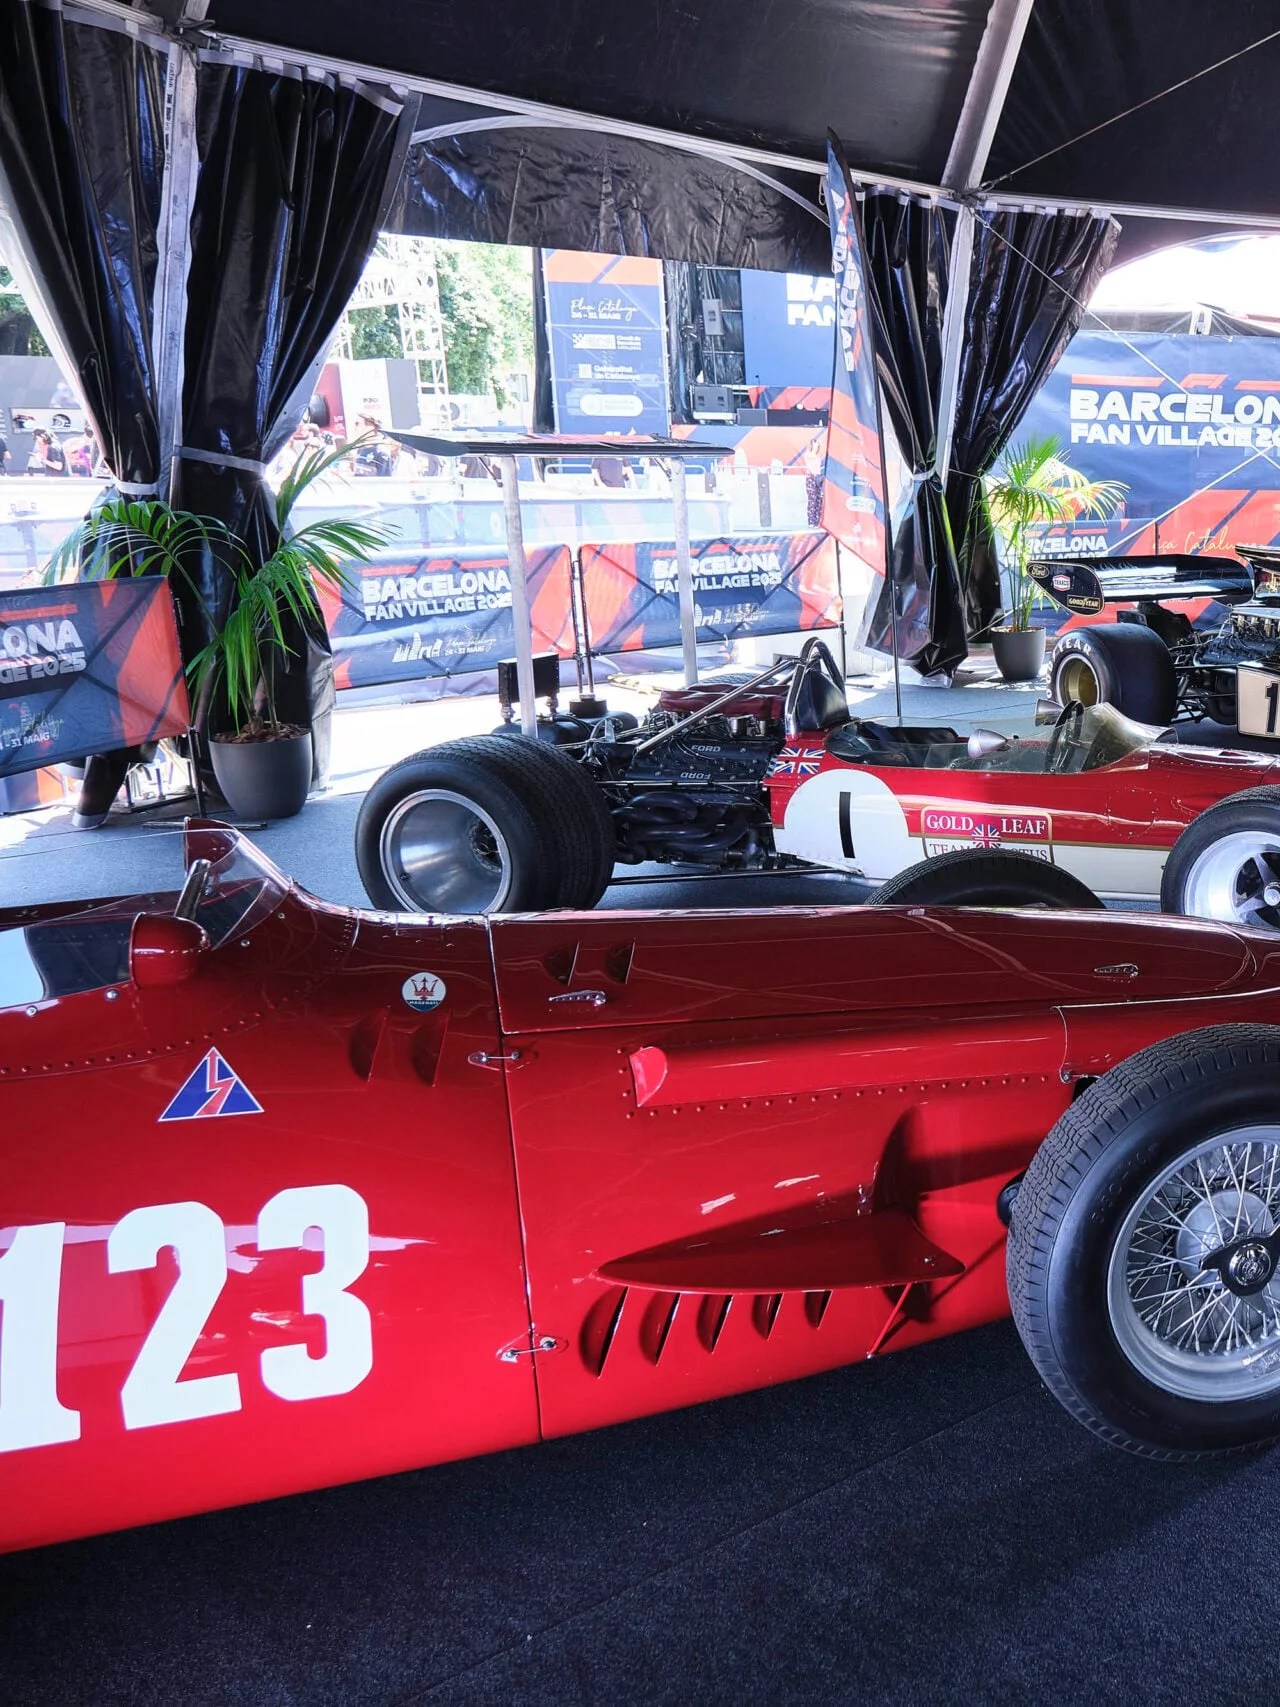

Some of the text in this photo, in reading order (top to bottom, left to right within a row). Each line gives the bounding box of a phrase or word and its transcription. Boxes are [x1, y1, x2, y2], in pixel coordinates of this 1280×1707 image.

[1070, 422, 1131, 445] FAN
[1135, 424, 1250, 447] VILLAGE
[362, 569, 513, 604] BARCELONA
[365, 605, 405, 622] FAN
[403, 598, 476, 617] VILLAGE
[31, 650, 88, 680] 2025
[1264, 681, 1280, 734] 1
[23, 731, 51, 745] MAIG
[691, 744, 721, 752] FORD
[680, 771, 712, 780] FORD
[838, 791, 856, 859] 1
[926, 814, 1046, 835] GOLD LEAF
[0, 1183, 373, 1453] 123
